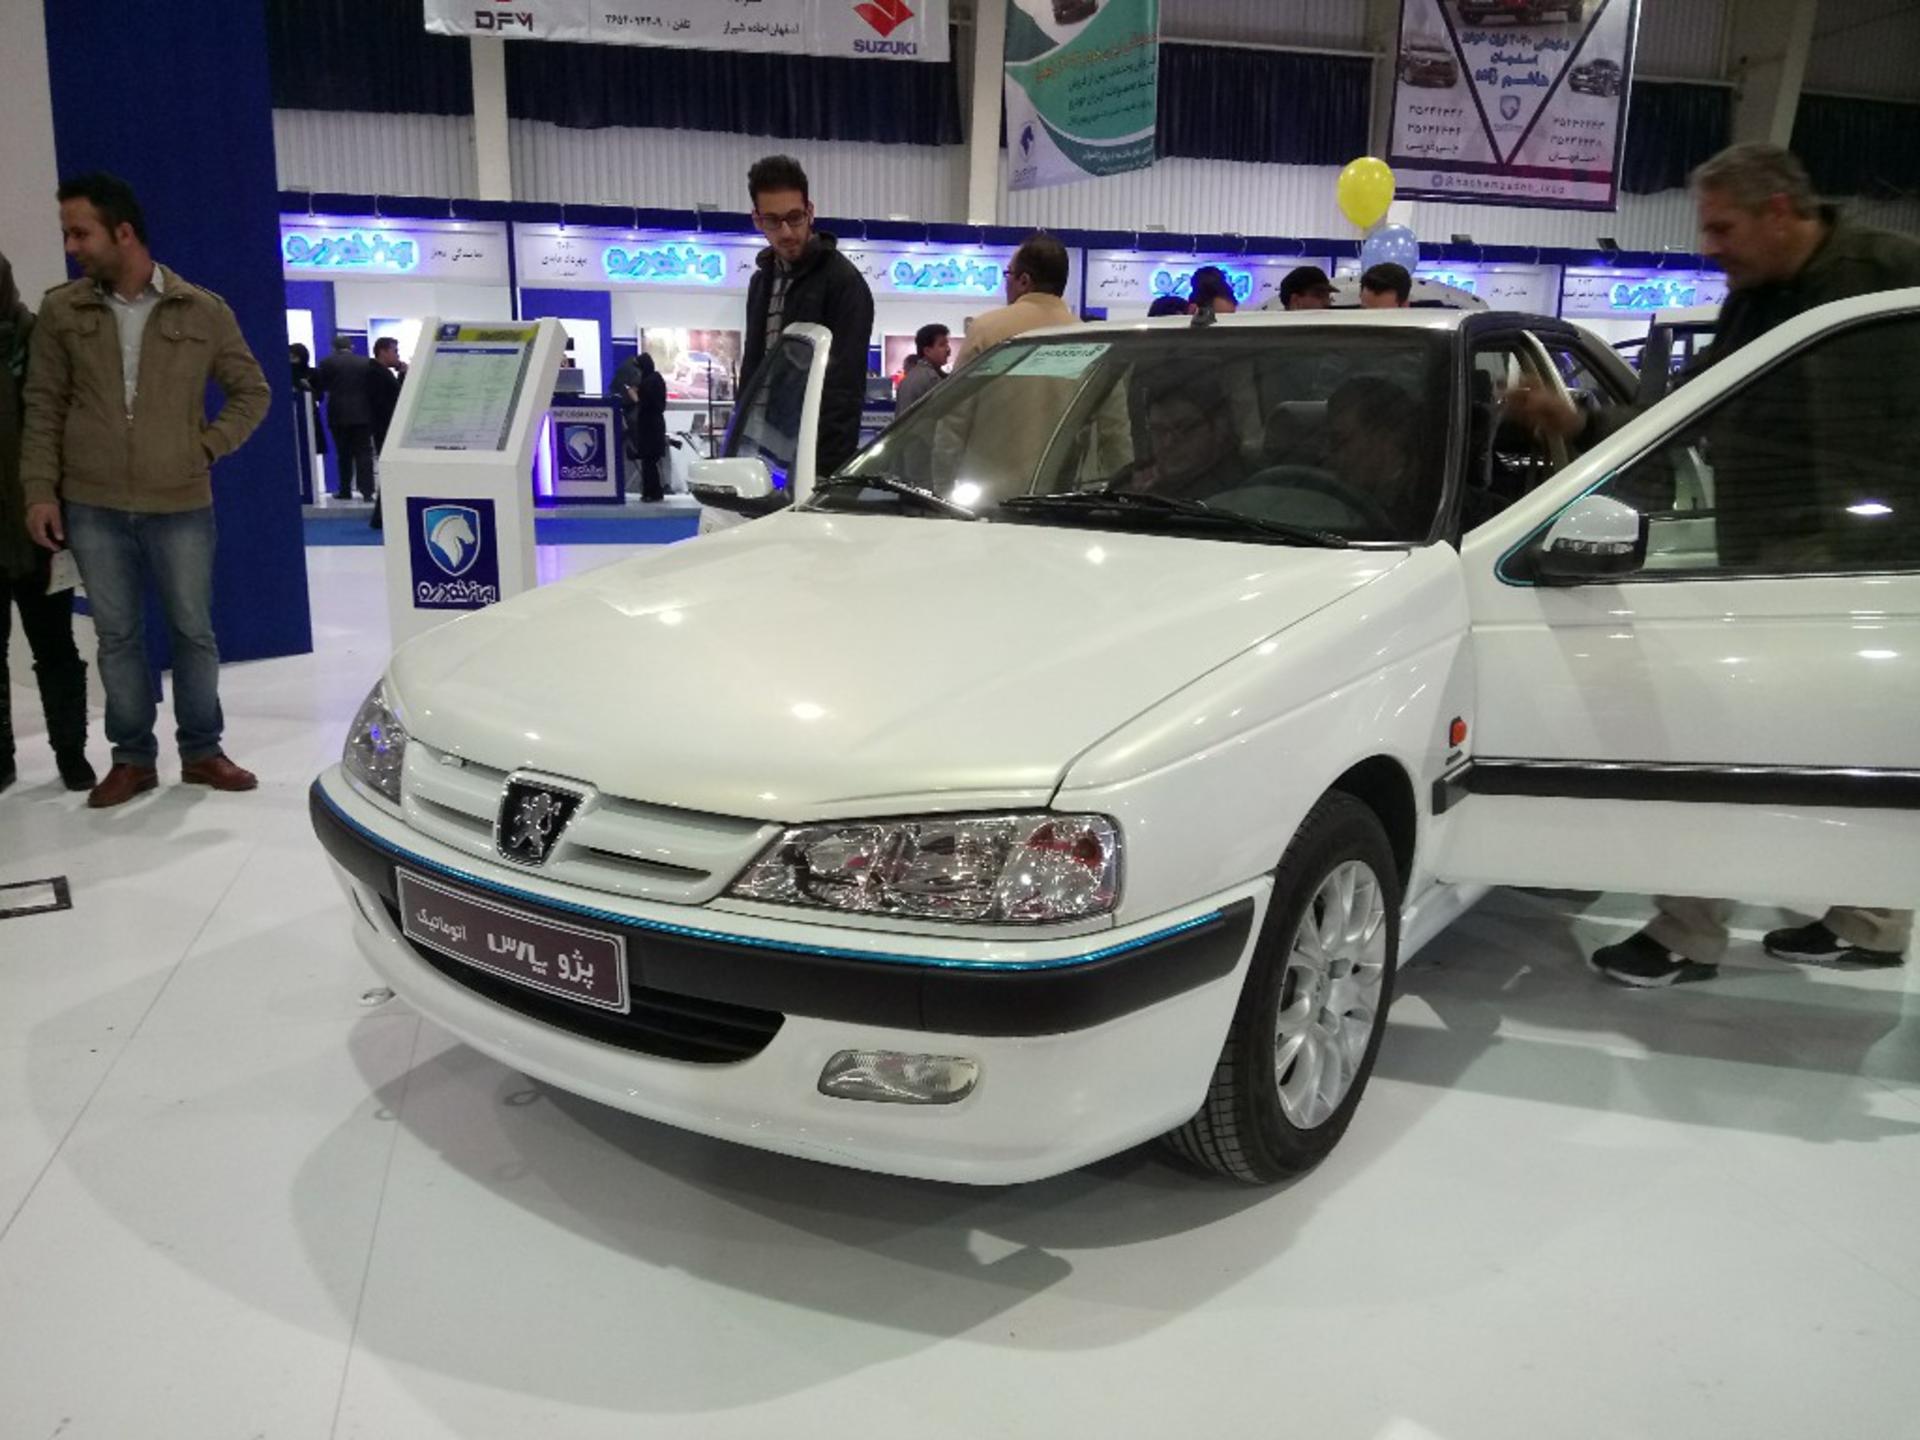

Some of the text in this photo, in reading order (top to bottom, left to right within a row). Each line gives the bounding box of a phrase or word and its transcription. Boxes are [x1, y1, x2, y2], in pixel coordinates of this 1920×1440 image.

[475, 11, 533, 31] DFM
[853, 39, 917, 55] SUZUKI
[1490, 50, 1539, 67] اصفهان
[415, 908, 595, 990] پژو پارس اتوماتیک
